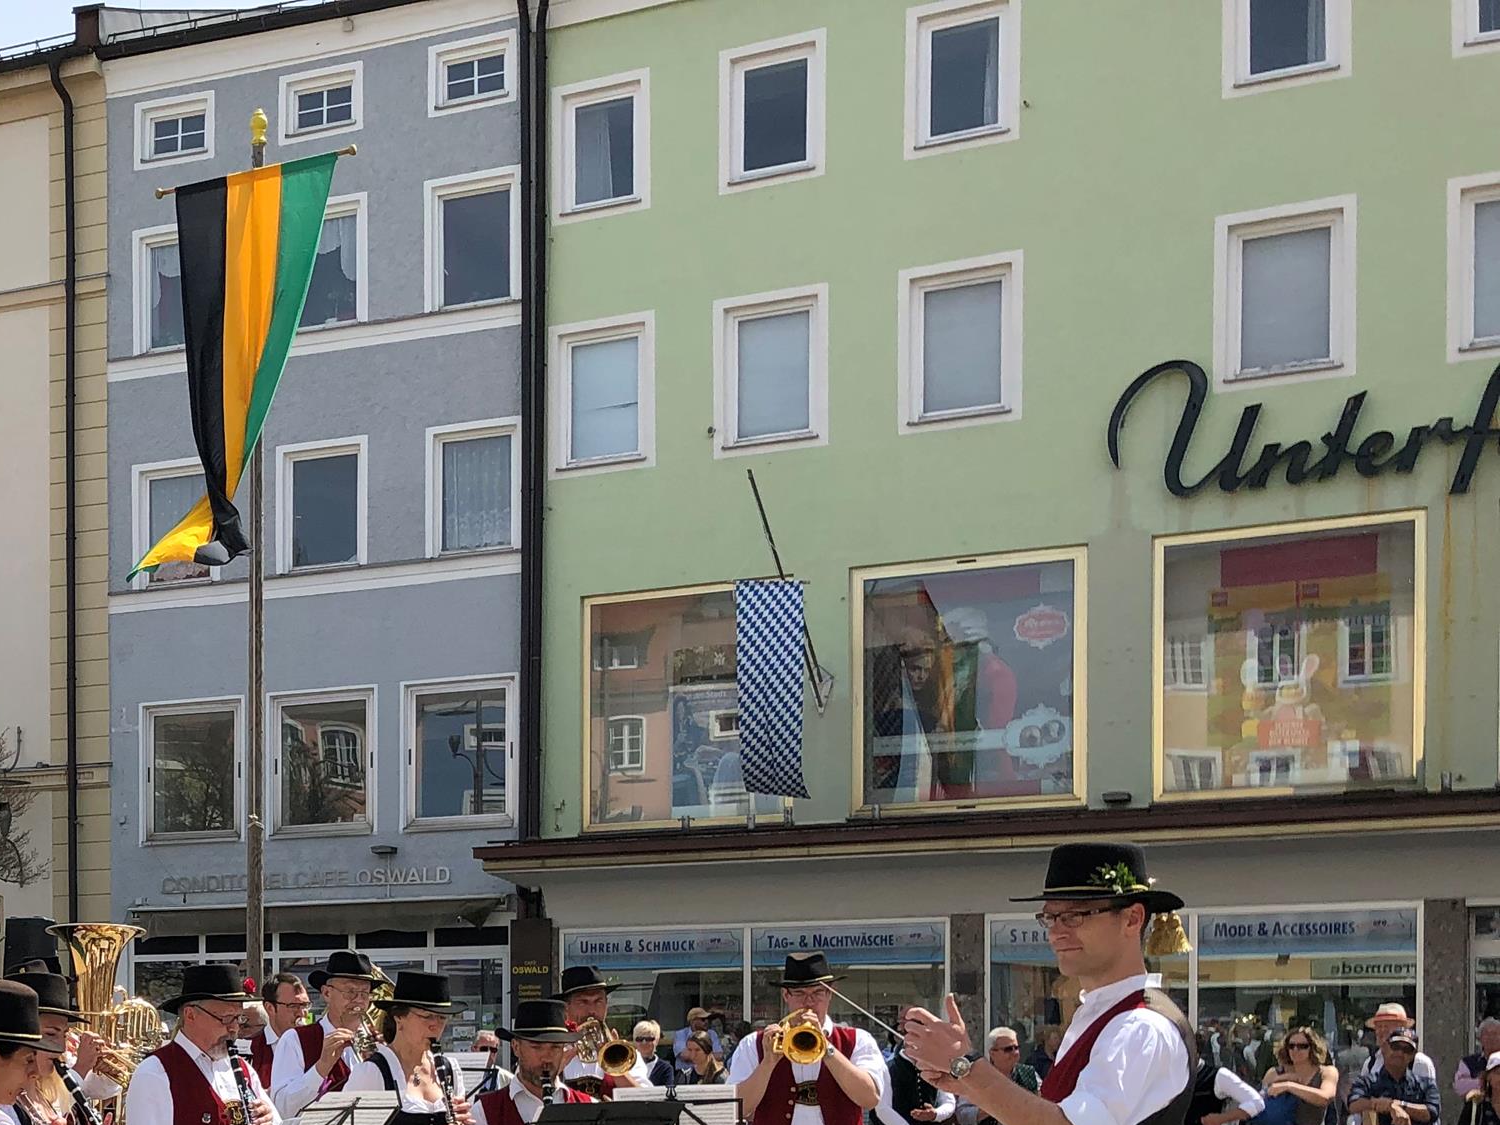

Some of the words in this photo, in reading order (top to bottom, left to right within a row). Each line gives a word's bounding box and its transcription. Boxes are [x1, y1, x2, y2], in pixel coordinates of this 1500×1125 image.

[1107, 358, 1500, 498] Unterf
[356, 866, 451, 885] OSWALD
[1213, 920, 1253, 938] MODE
[1257, 920, 1269, 937] &
[1272, 919, 1356, 937] ACCESSOIRES
[580, 940, 620, 954] UHREN
[624, 939, 633, 953] &
[638, 938, 695, 953] SCHMUCK
[798, 934, 808, 947] &
[512, 966, 549, 975] OSWALD
